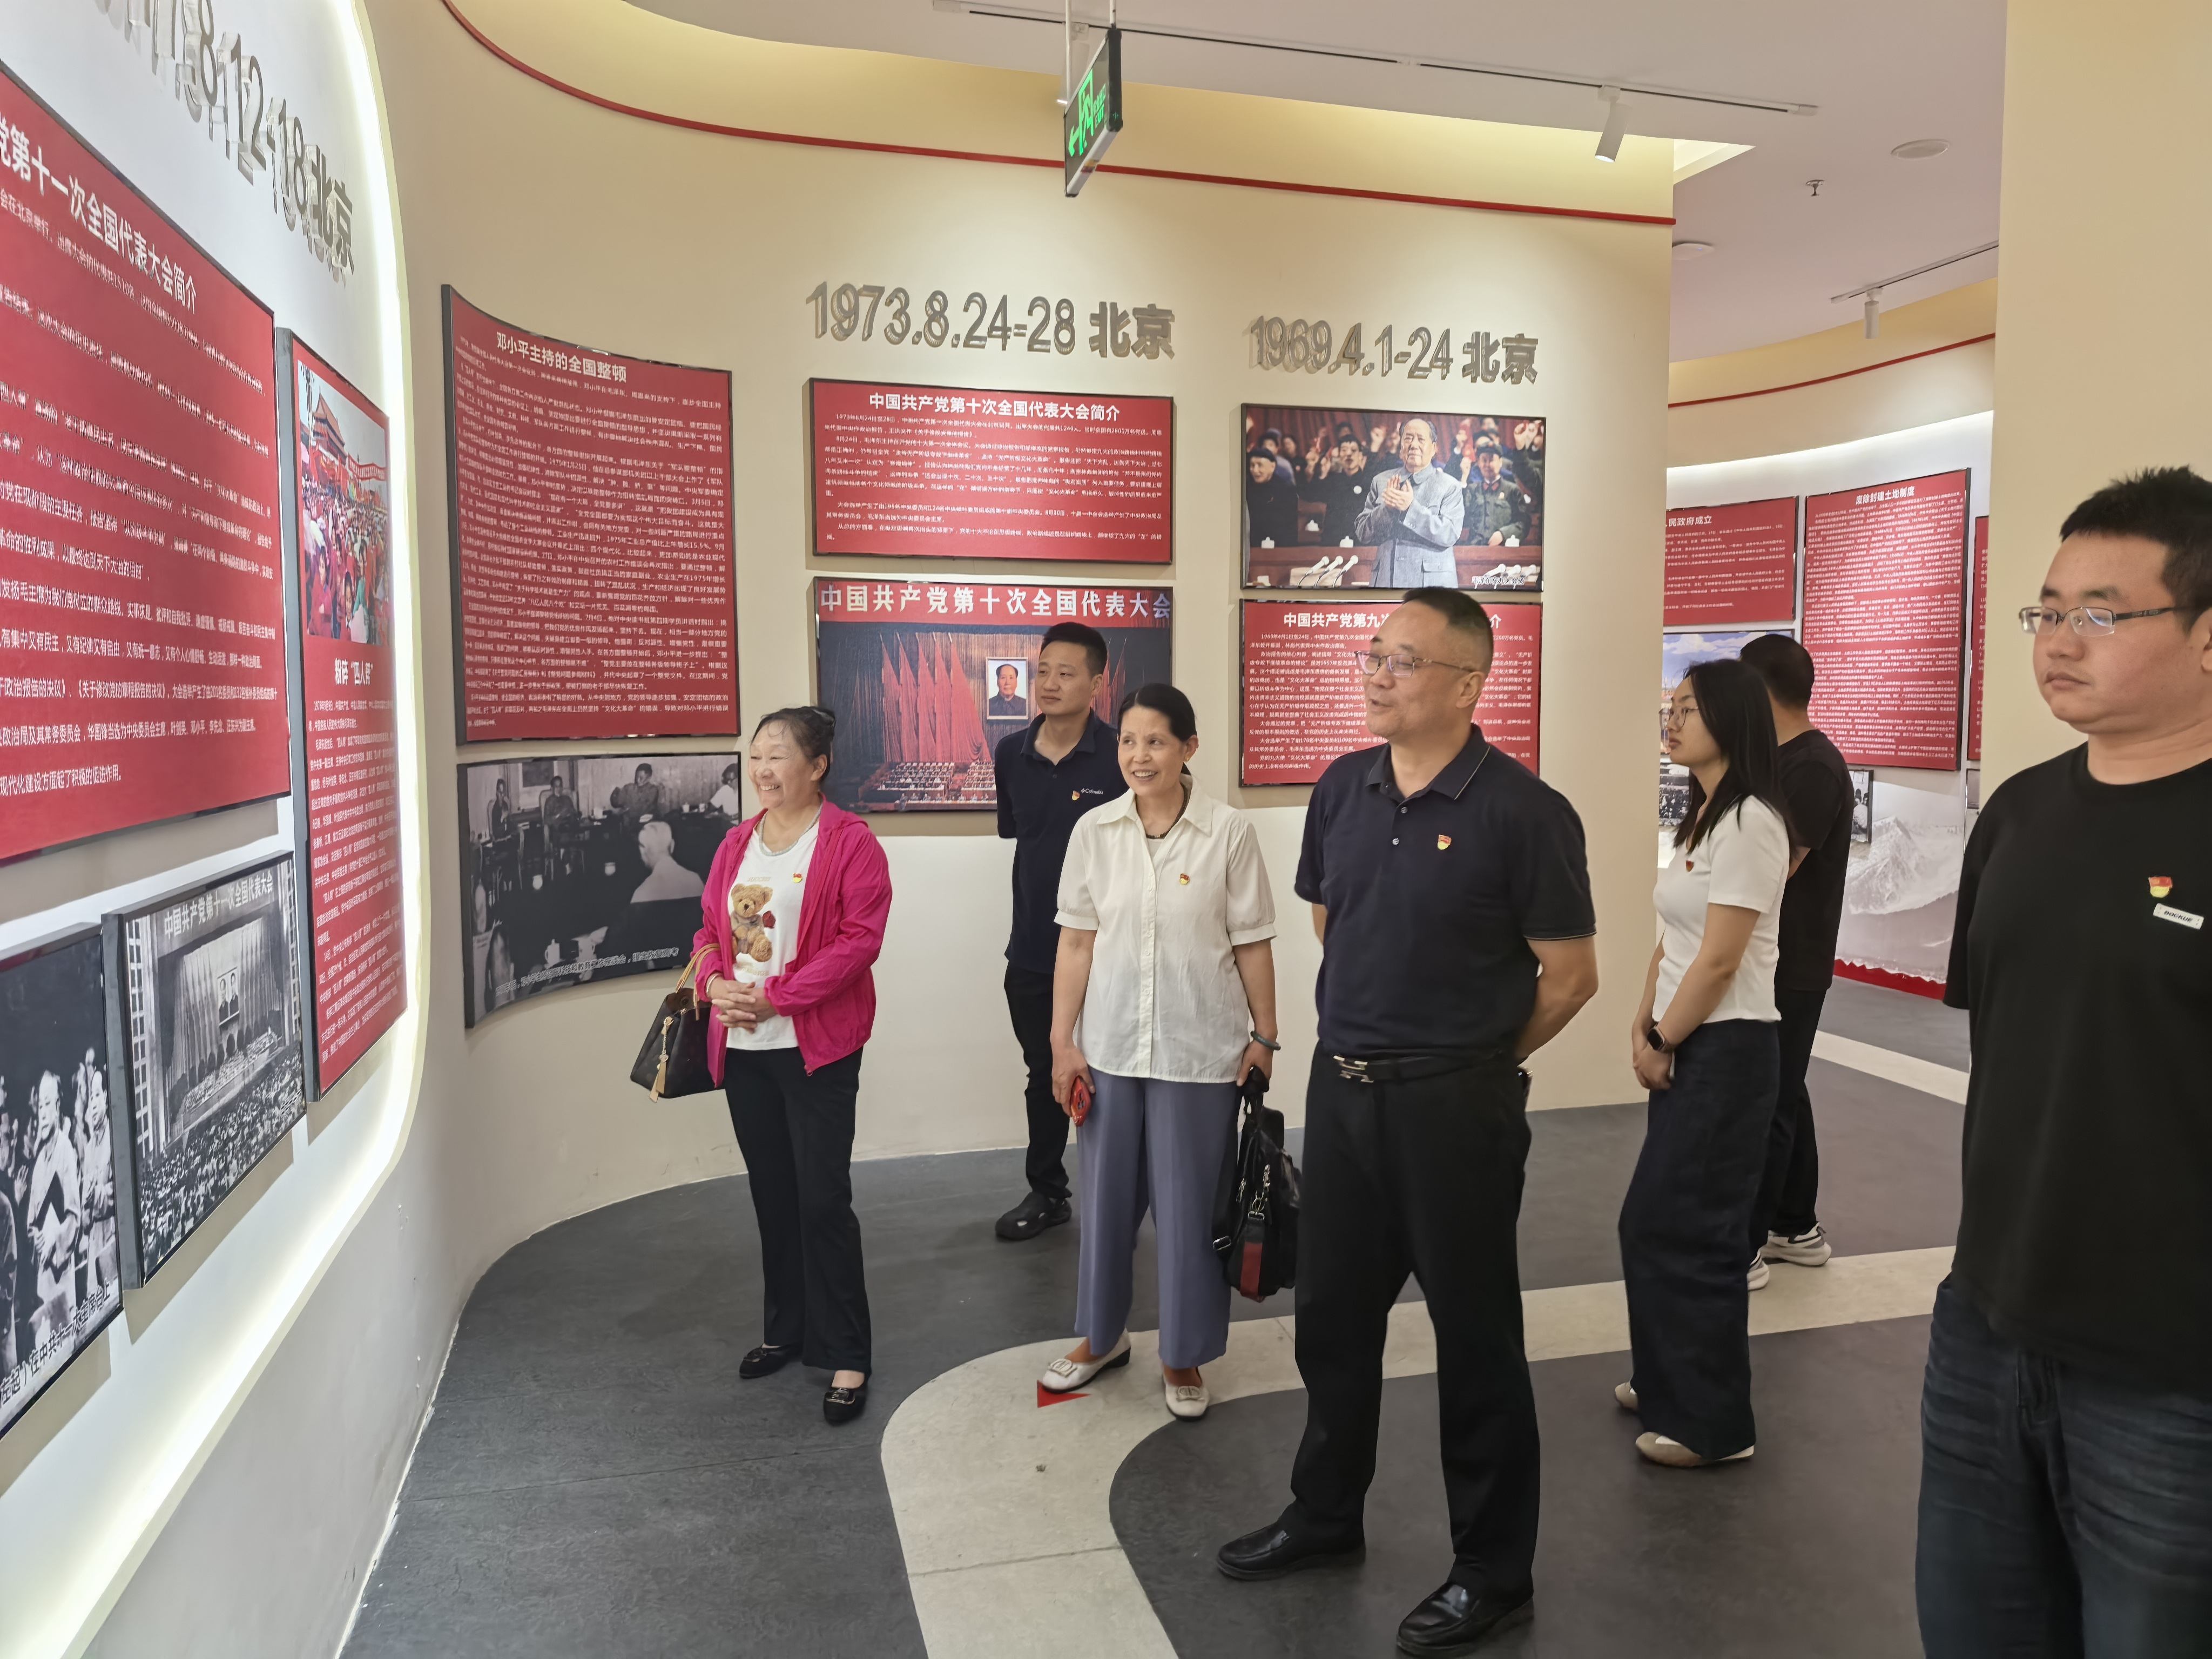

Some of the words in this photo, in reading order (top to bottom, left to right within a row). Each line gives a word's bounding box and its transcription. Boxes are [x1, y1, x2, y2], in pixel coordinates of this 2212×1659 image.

[1095, 103, 1104, 129] EXIT
[806, 281, 1075, 354] 1973.8.24-28
[1089, 301, 1176, 359] 北京
[496, 331, 626, 383] 邓小平主持的全国整顿
[1250, 315, 1454, 381] 1969.4.1-24
[1461, 331, 1539, 385] 北京
[869, 392, 1121, 422] 中国共产党第十次全国代表大会简介
[1856, 485, 1916, 505] 废除封建土地制度
[1665, 515, 1712, 527] 民政府成立
[820, 584, 1171, 619] 中国共产党第十次全国代表大会
[164, 868, 274, 938] 中国共产党第十一次全国代表大会
